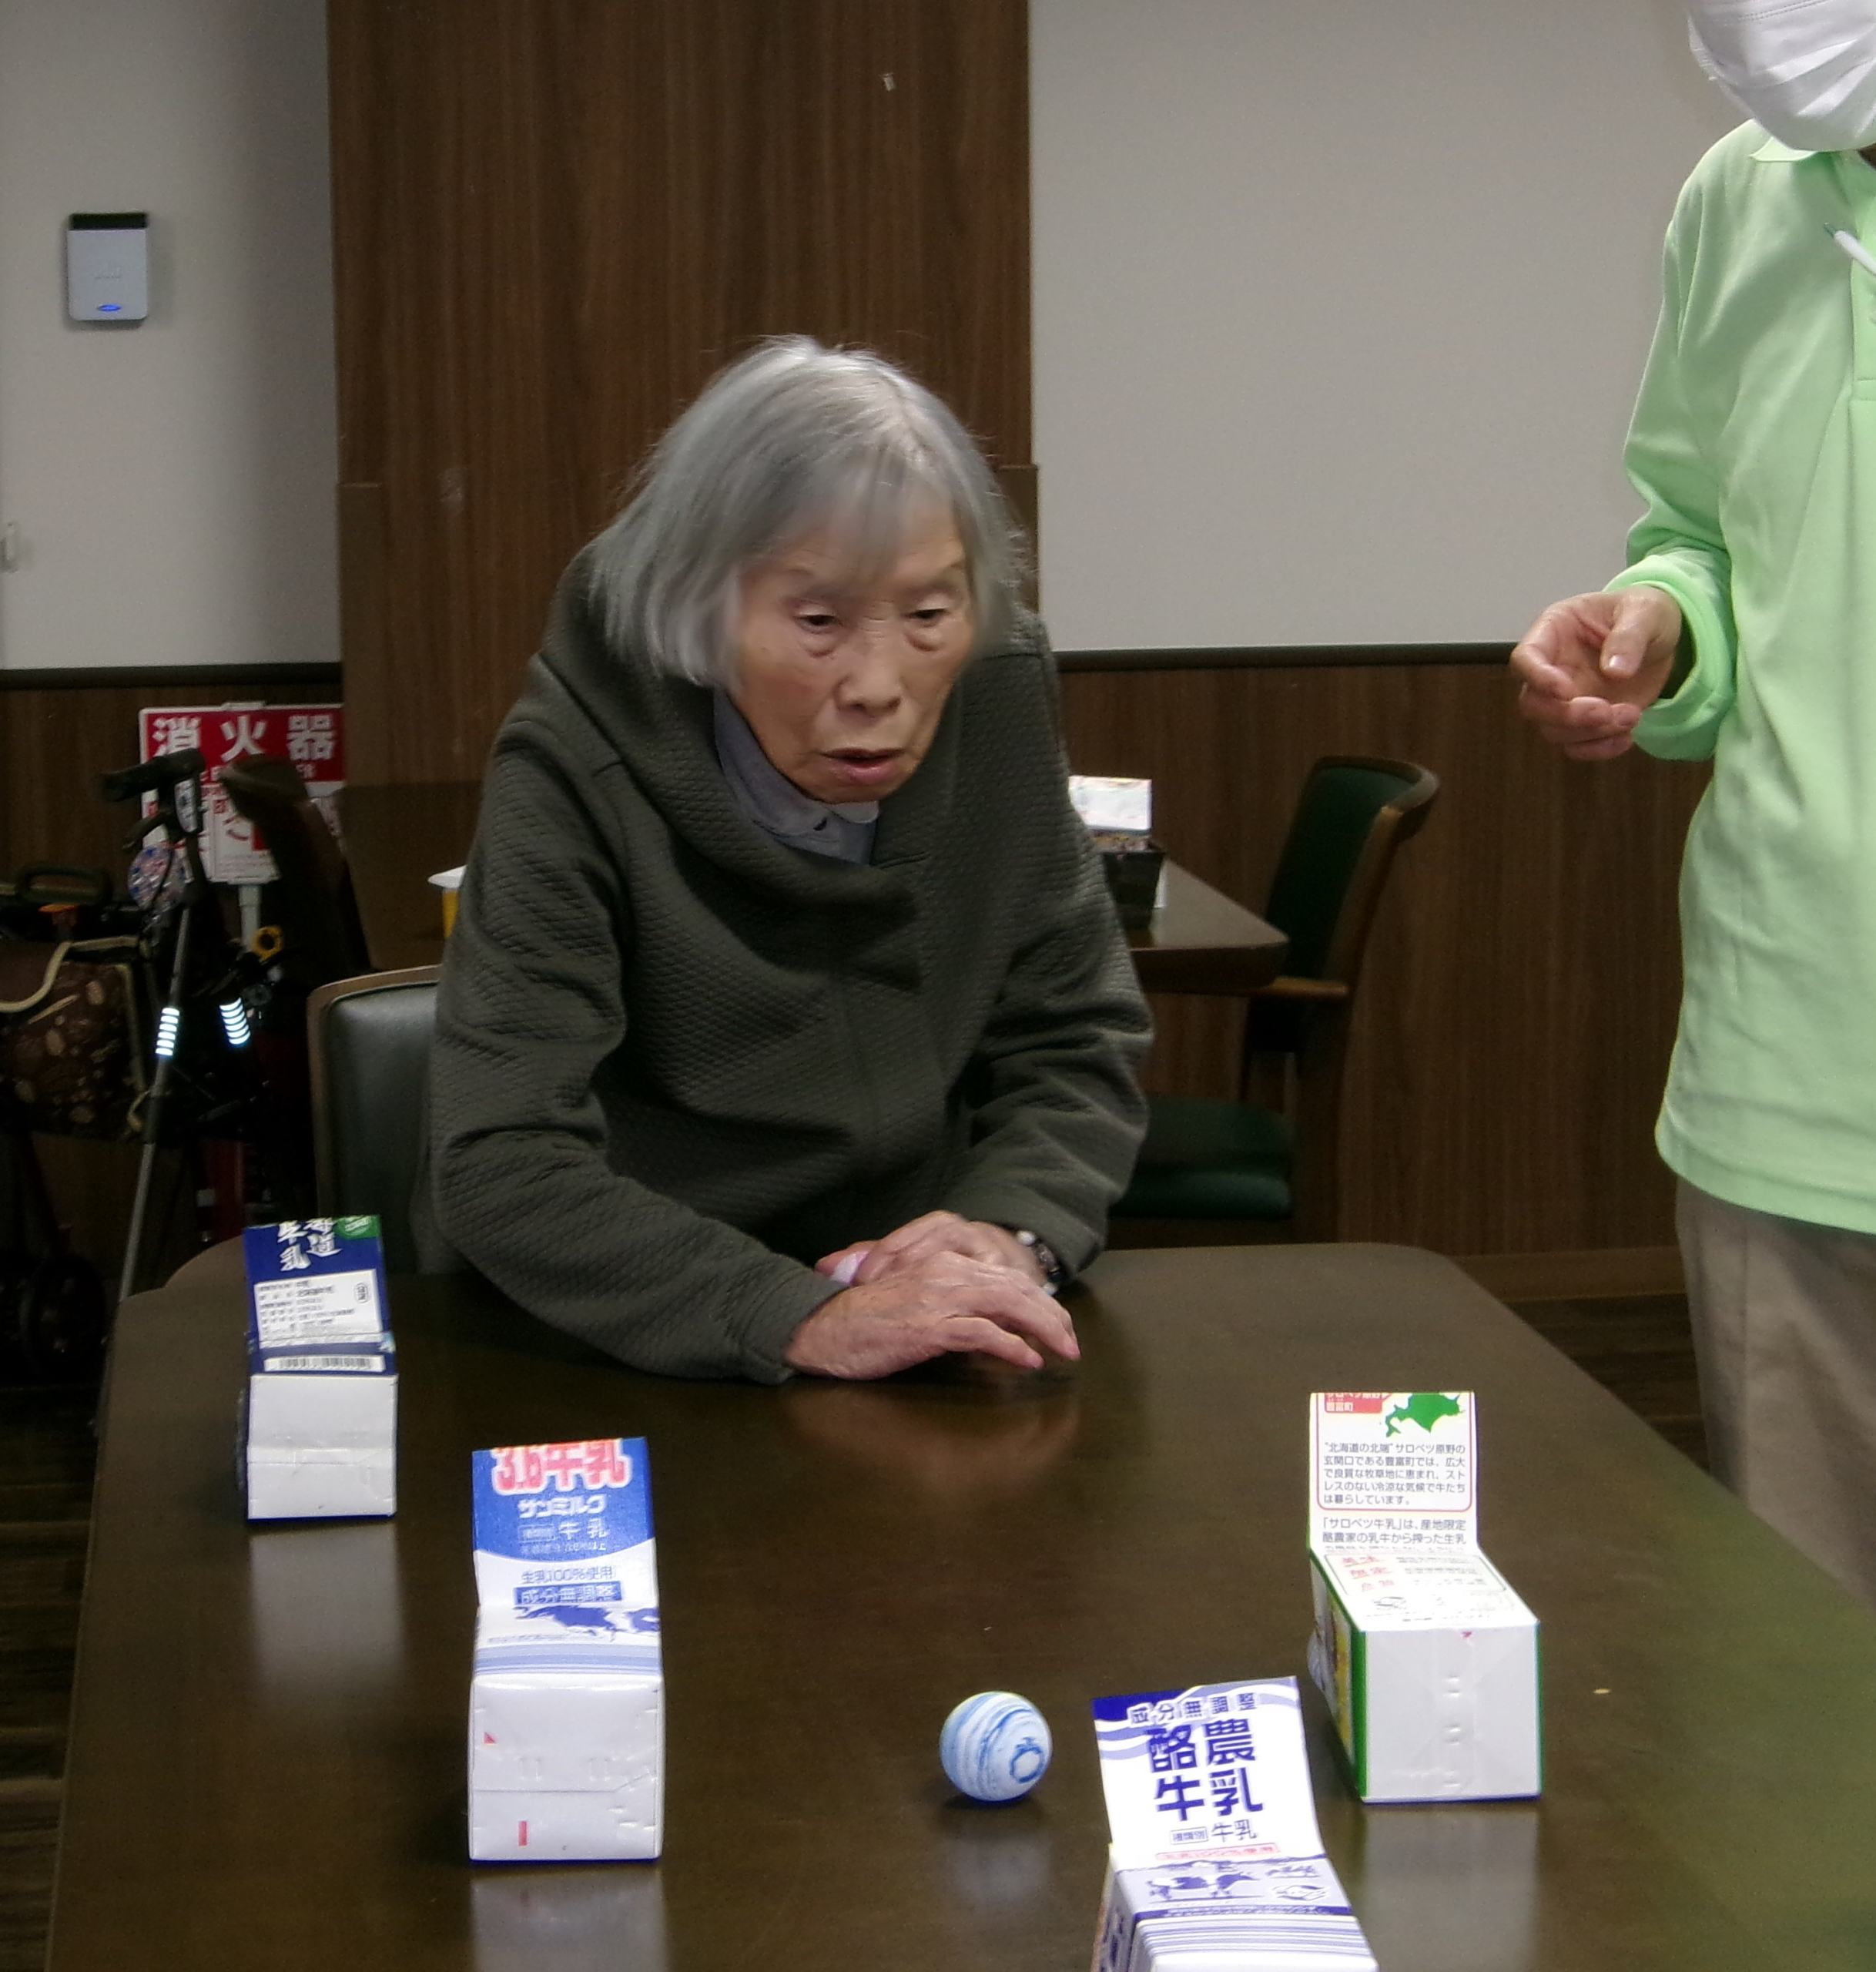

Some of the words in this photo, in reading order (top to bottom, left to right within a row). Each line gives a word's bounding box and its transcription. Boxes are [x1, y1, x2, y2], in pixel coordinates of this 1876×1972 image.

[152, 714, 337, 763] 消火器
[518, 1494, 606, 1518] サンミルク
[1324, 1494, 1410, 1505] は暮らしています。
[521, 1585, 615, 1603] 成分無調整
[1131, 1693, 1257, 1724] 成分無調整
[1146, 1719, 1256, 1773] 酪農
[1154, 1767, 1264, 1822] 牛乳
[1211, 1819, 1257, 1843] 牛乳
